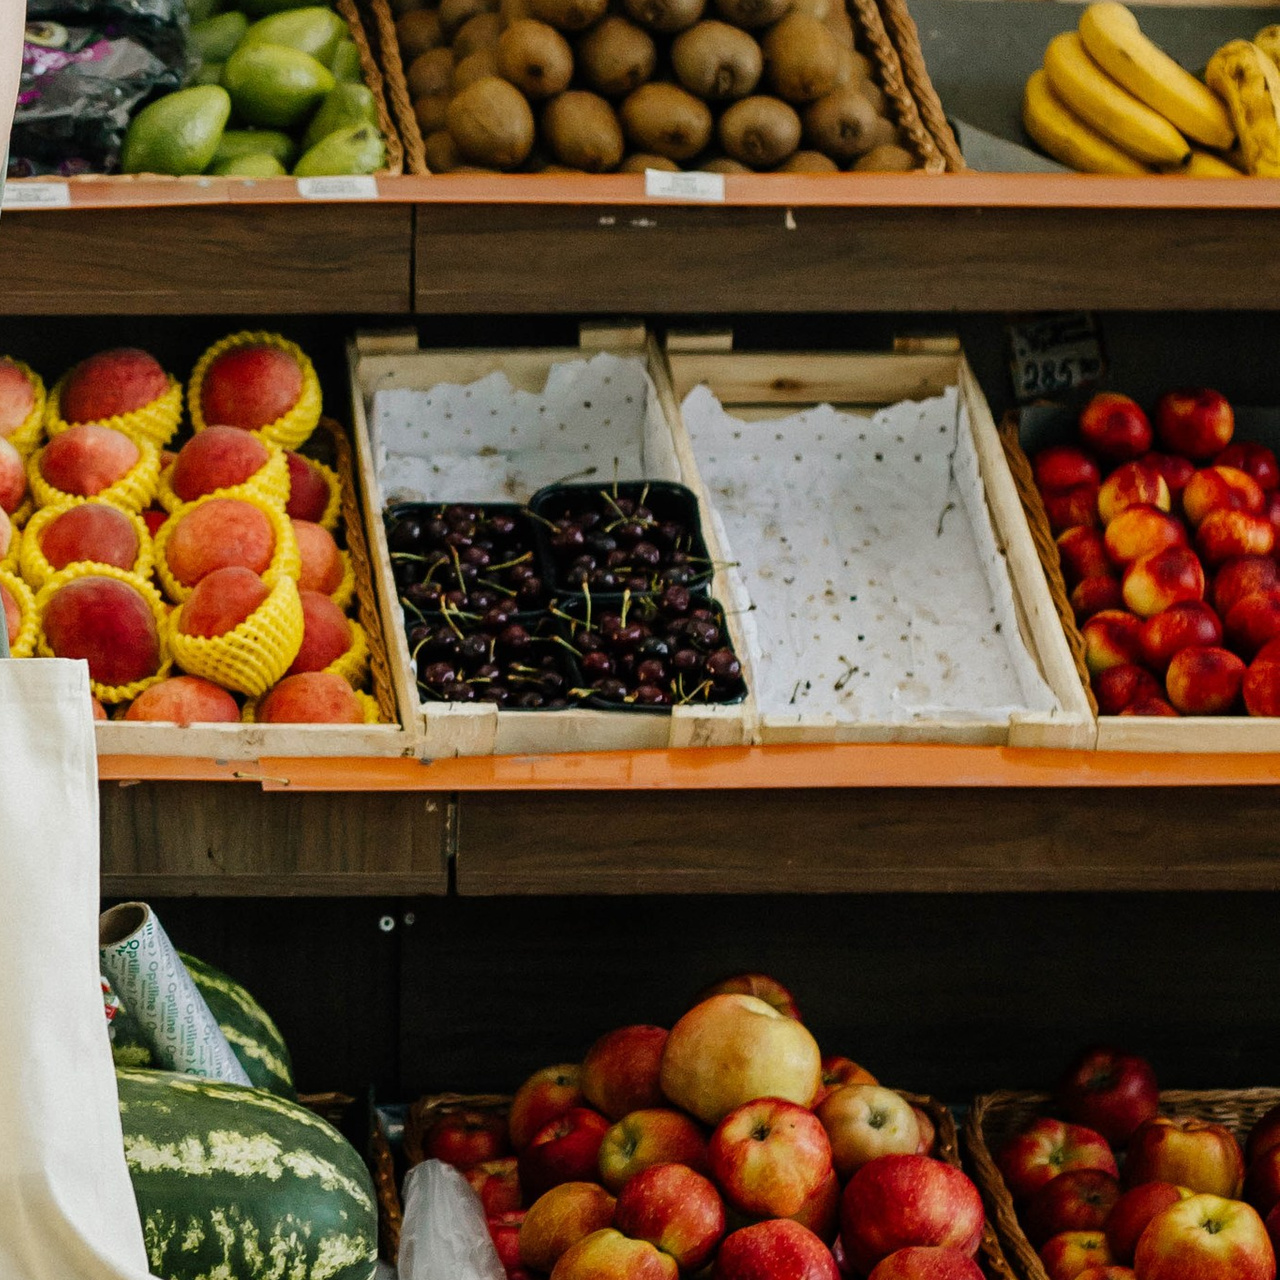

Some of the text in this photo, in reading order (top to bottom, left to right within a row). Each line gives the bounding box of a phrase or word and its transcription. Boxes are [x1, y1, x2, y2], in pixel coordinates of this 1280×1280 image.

[146, 960, 160, 1011] Optiline
[165, 982, 178, 1034] Optiline
[184, 1003, 197, 1056] Optiline
